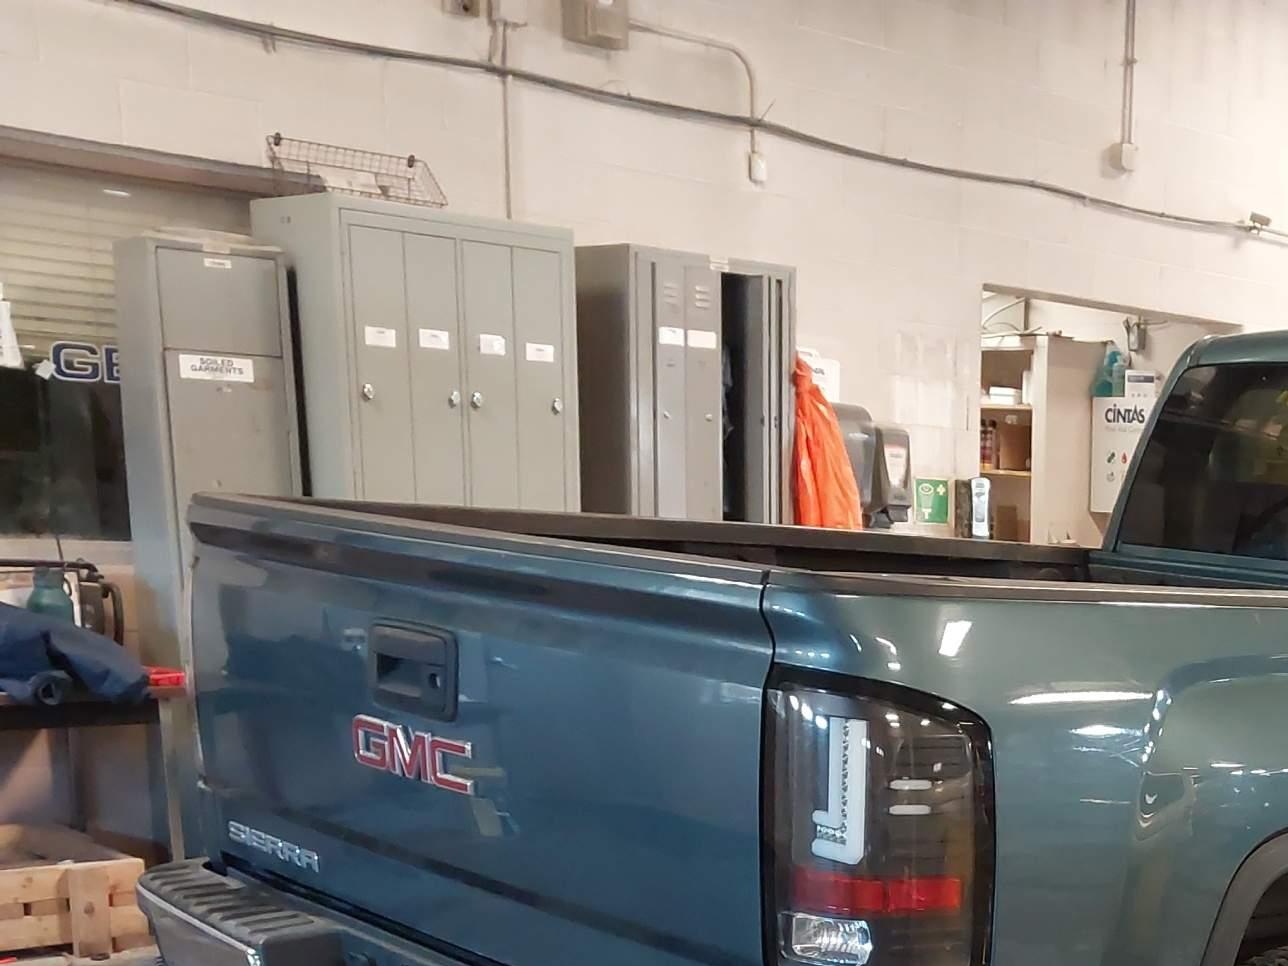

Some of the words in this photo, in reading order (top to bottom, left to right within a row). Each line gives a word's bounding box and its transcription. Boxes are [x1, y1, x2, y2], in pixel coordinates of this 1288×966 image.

[190, 364, 244, 375] GARMENTS
[199, 357, 234, 367] SOILED
[352, 714, 474, 795] GMC
[228, 820, 320, 873] SIERRA
